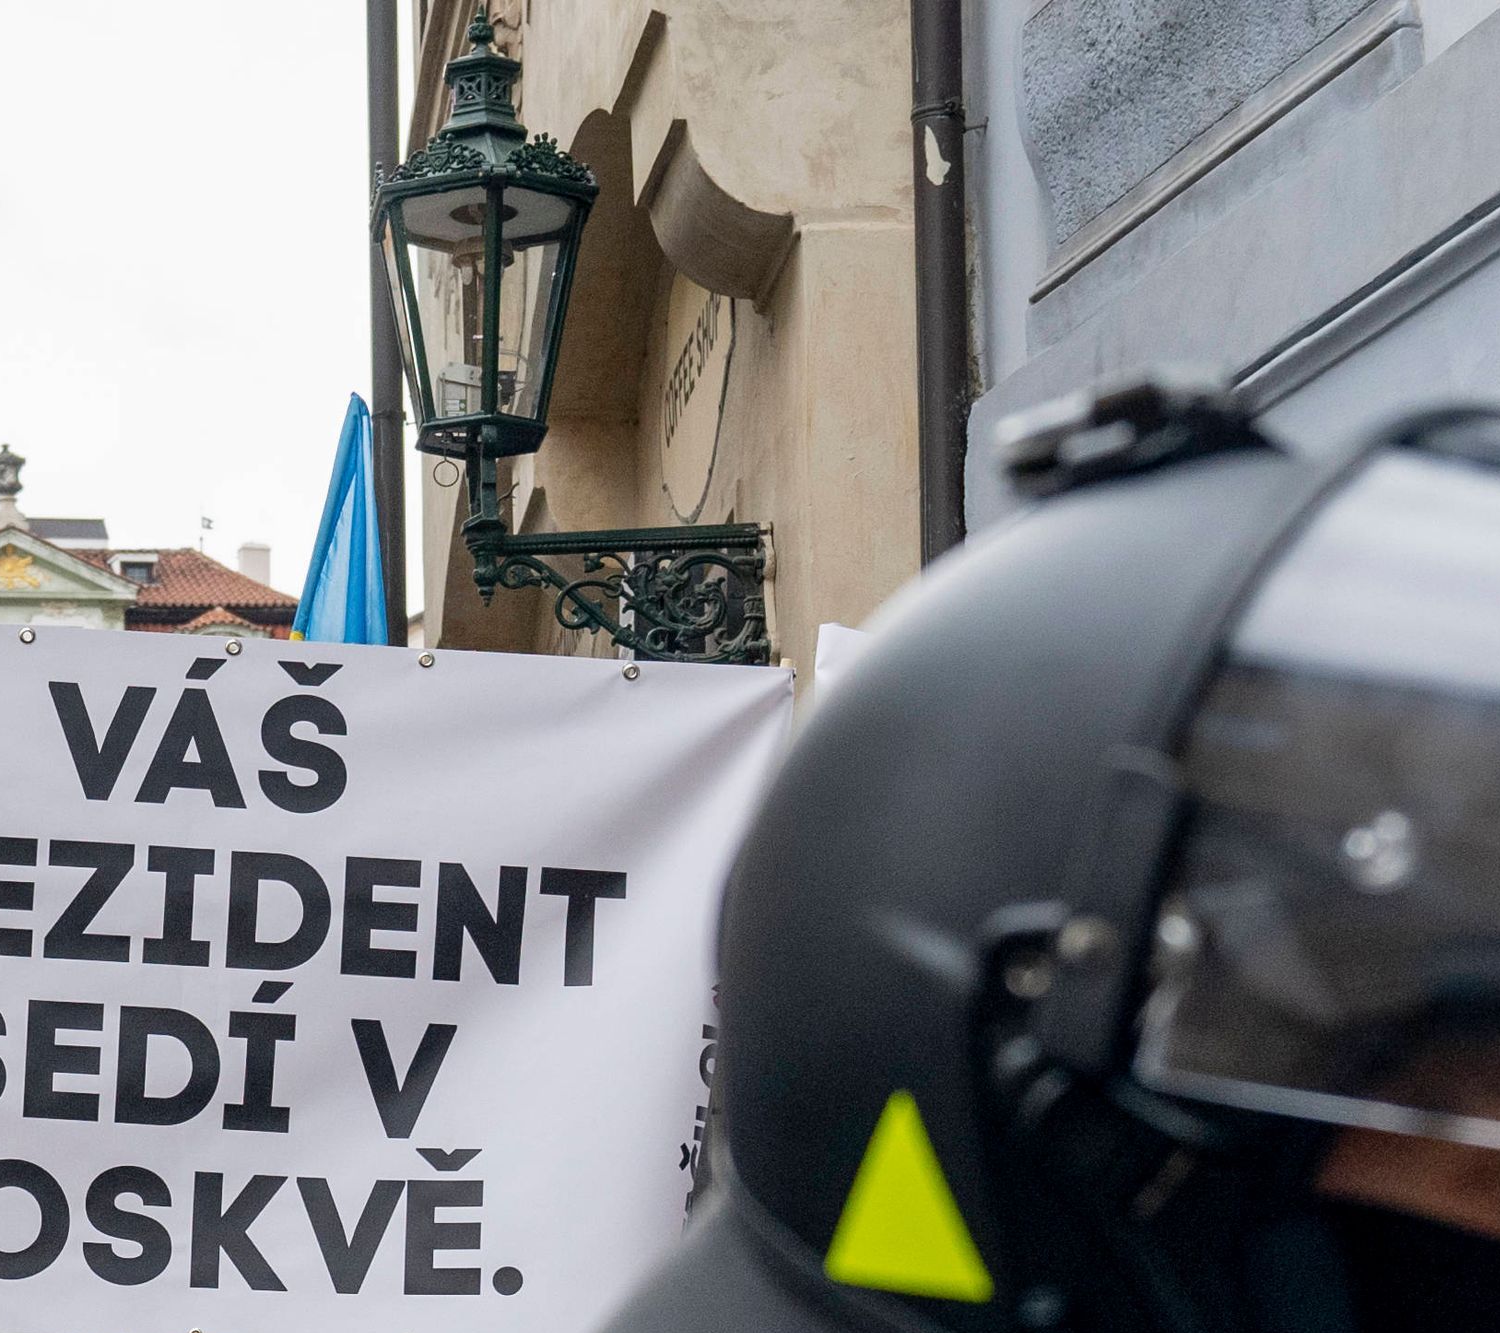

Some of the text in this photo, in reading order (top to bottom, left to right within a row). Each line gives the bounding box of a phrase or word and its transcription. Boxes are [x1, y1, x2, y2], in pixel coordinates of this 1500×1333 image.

[664, 292, 721, 449] COFFEE SHOP
[48, 657, 349, 814] VÁŠ
[350, 1018, 458, 1139] V
